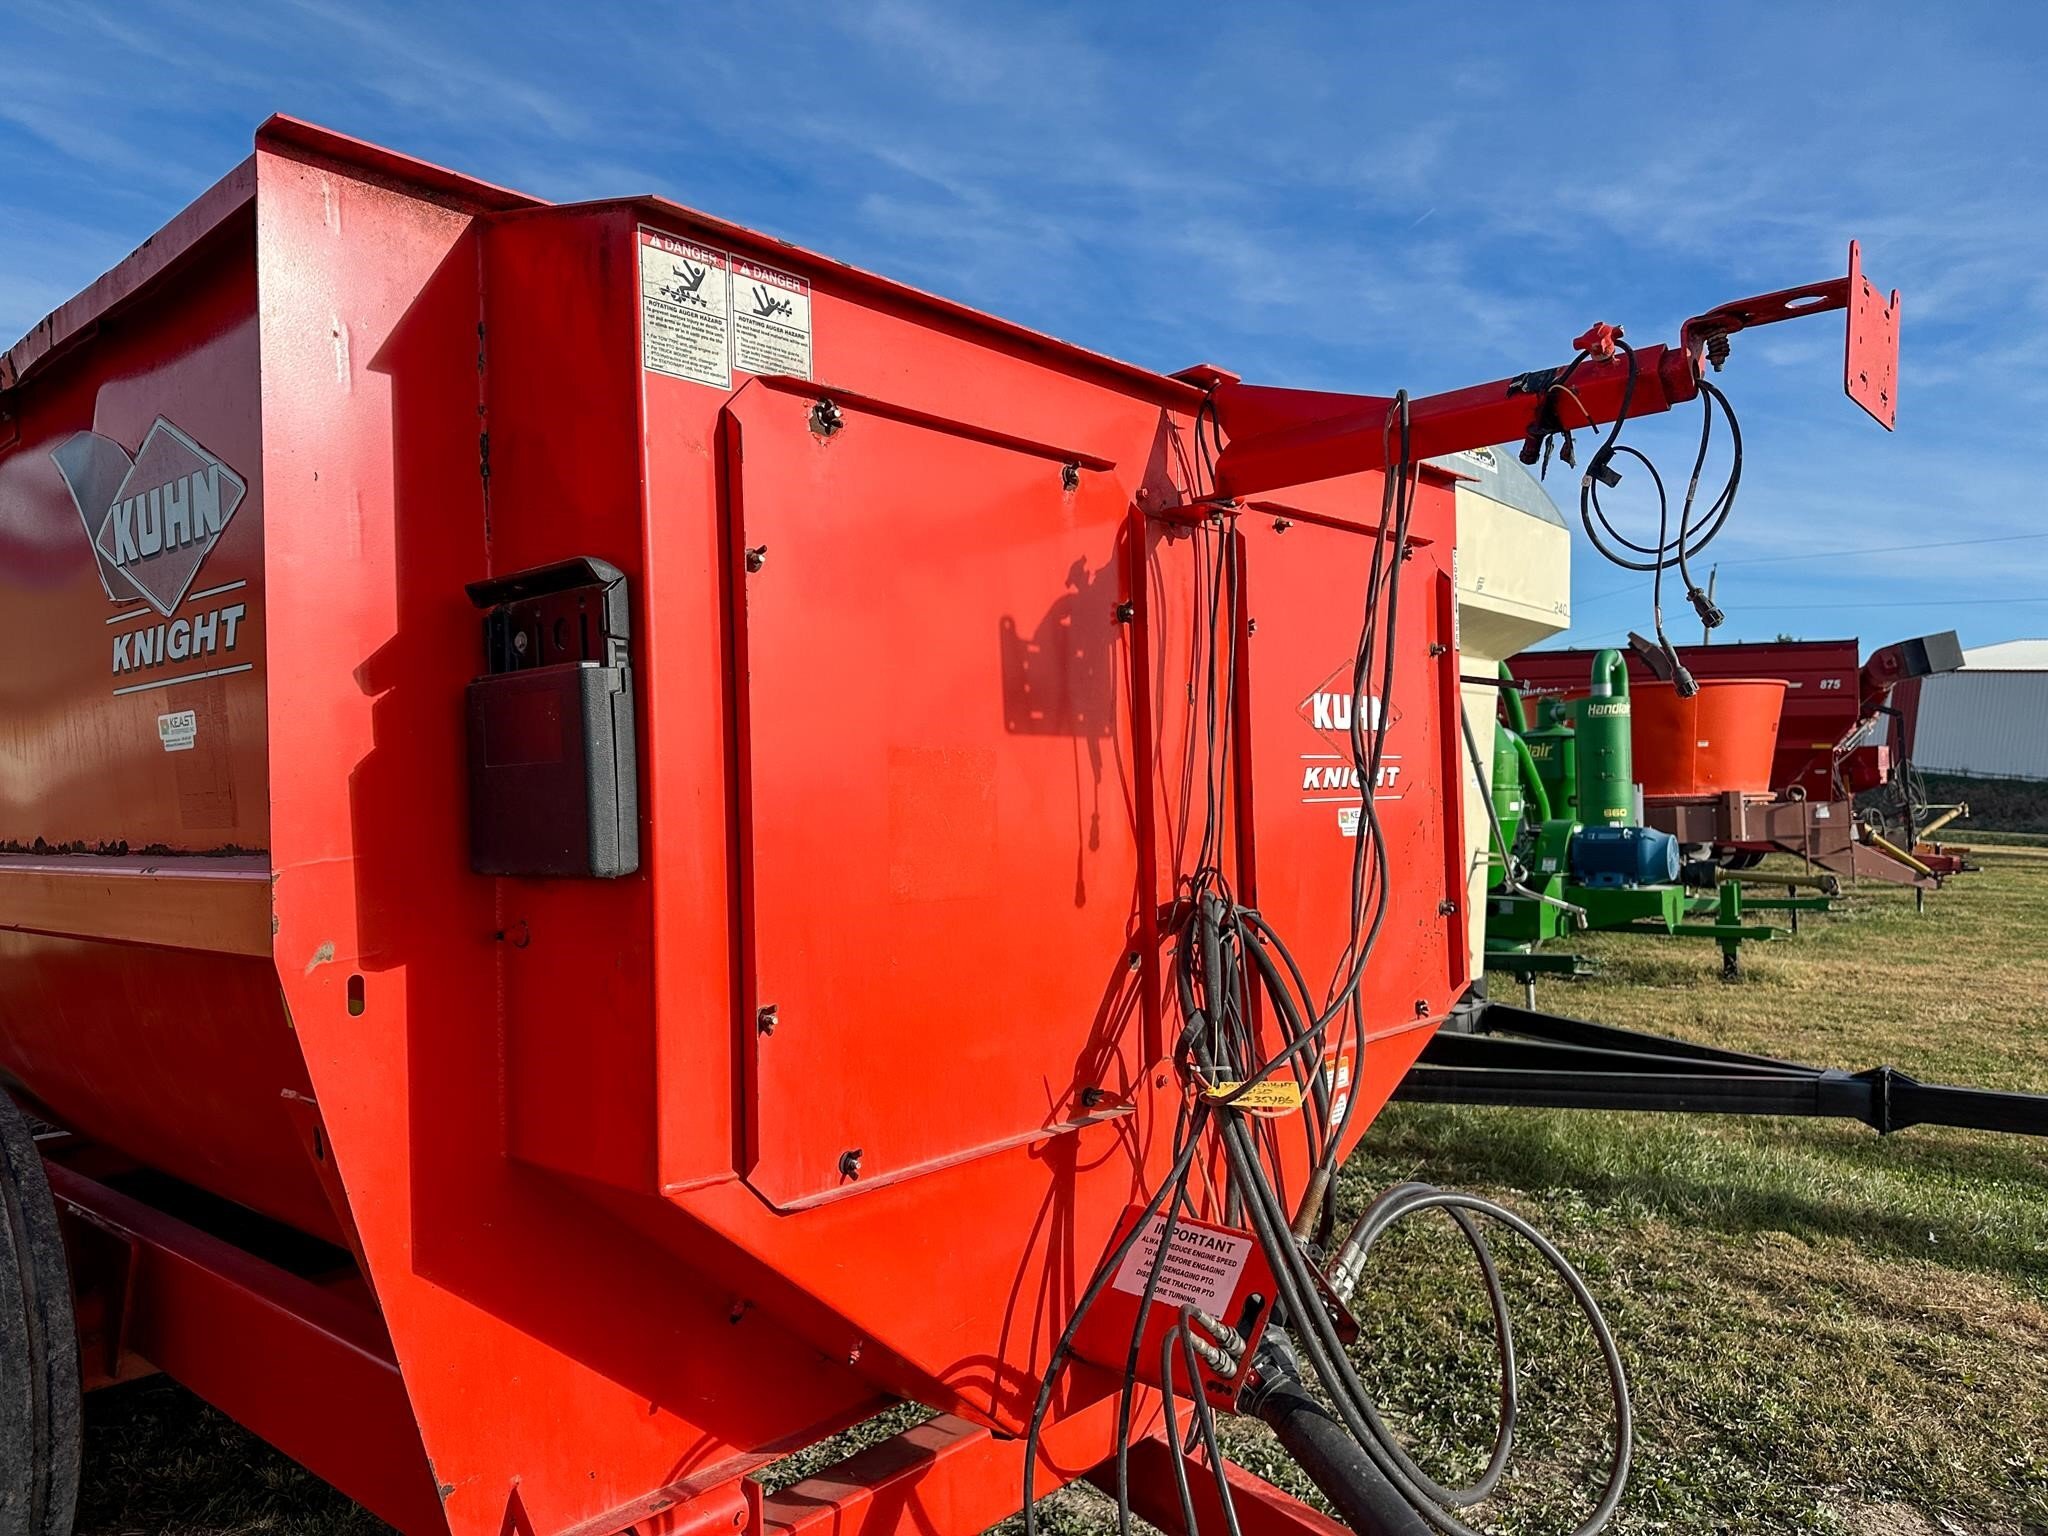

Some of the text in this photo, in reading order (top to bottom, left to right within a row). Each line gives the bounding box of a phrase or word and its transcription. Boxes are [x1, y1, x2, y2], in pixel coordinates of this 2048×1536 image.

[664, 237, 717, 266] DANGER
[753, 266, 801, 291] DANGER
[648, 300, 723, 325] ROTATING AUGER HAZARD
[738, 316, 805, 340] ROTATING AUGER HAZARD
[112, 463, 222, 567] KUHN
[112, 603, 246, 673] KNIGHT
[1820, 679, 1841, 690] 875
[169, 714, 194, 729] KEAST
[1144, 1247, 1153, 1255] TO
[1166, 1254, 1192, 1267] BEFORE
[1192, 1261, 1226, 1276] ENGAGING
[1191, 1249, 1216, 1262] ENGINE
[1215, 1256, 1238, 1268] SPEED
[1161, 1264, 1201, 1281] ISENGAGING
[1200, 1275, 1215, 1286] PTO.
[1171, 1279, 1202, 1294] TRACTOR
[1201, 1288, 1215, 1298] PTO
